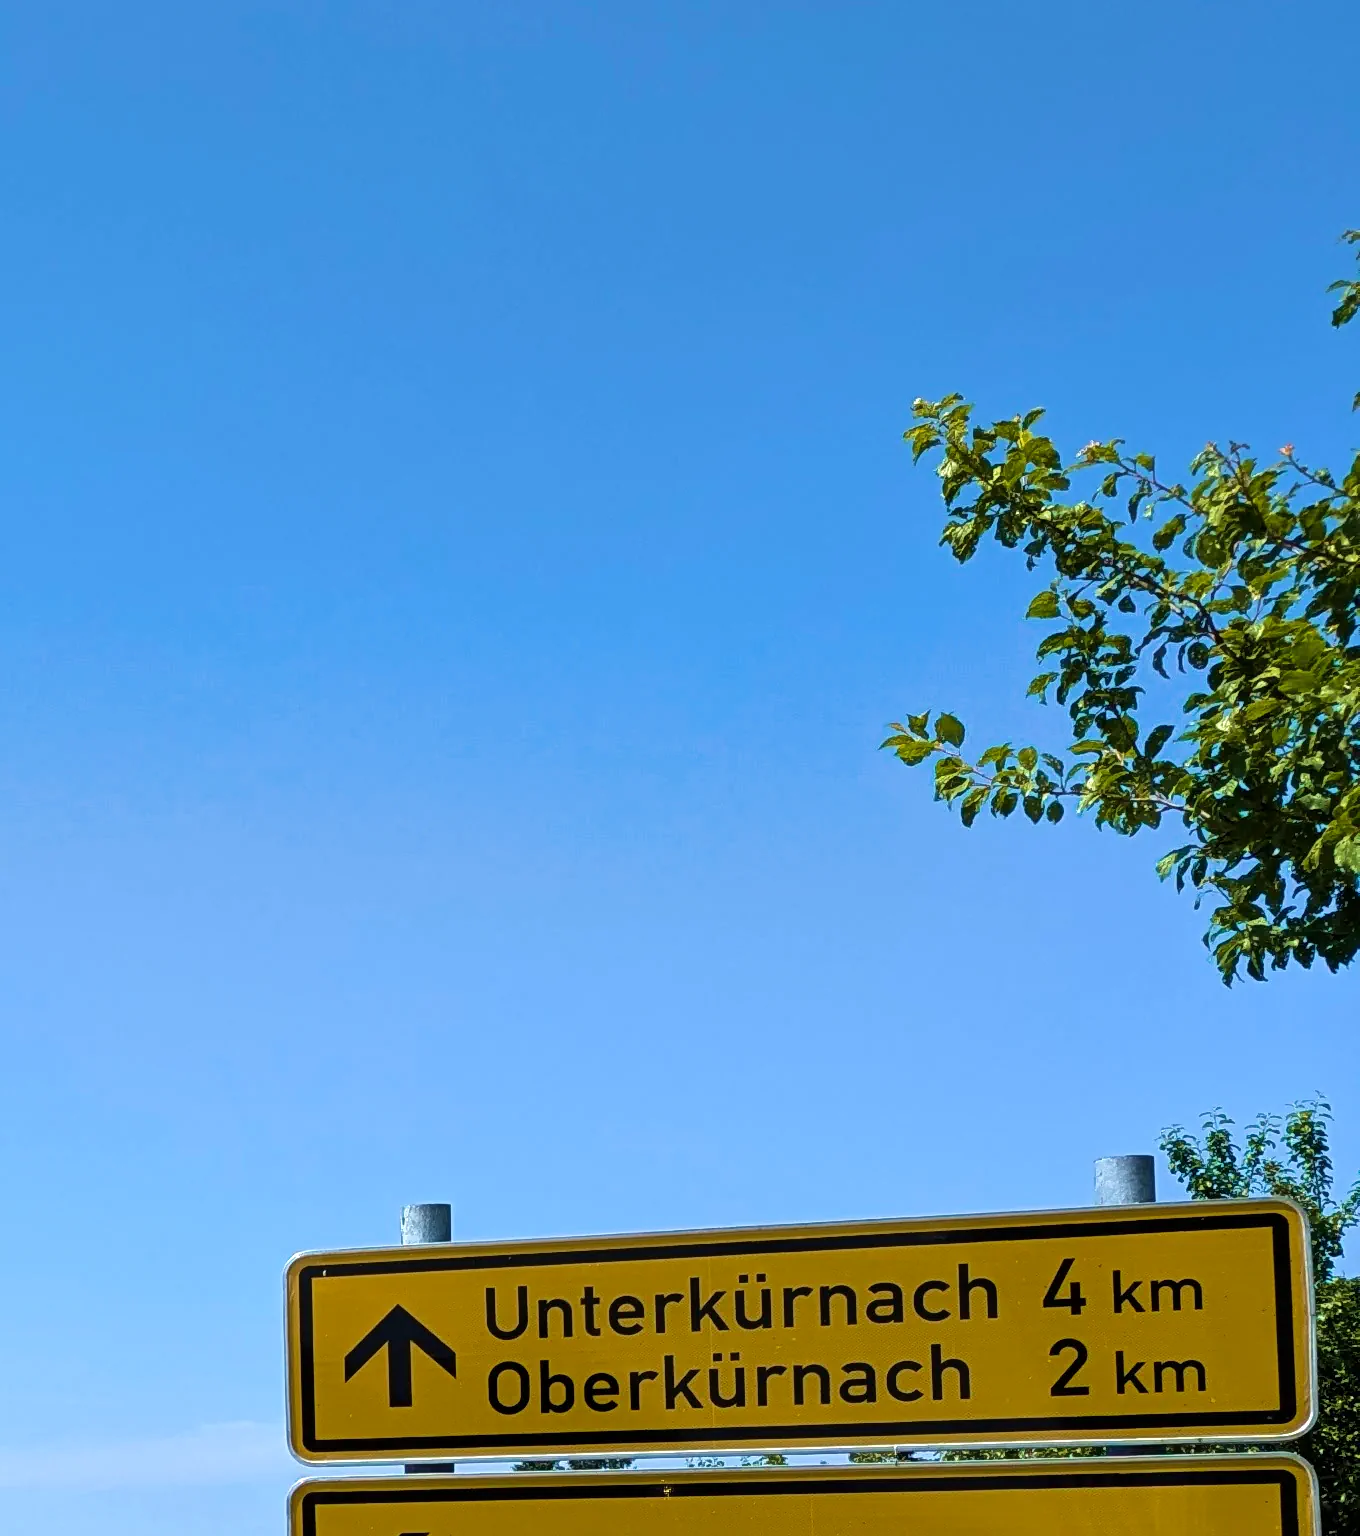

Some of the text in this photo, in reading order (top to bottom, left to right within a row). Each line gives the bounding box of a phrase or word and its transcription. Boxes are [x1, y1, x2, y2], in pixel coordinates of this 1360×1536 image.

[484, 1257, 1205, 1342] Unterkürnach 4 km
[486, 1337, 1208, 1416] Oberkürnach 2 km
